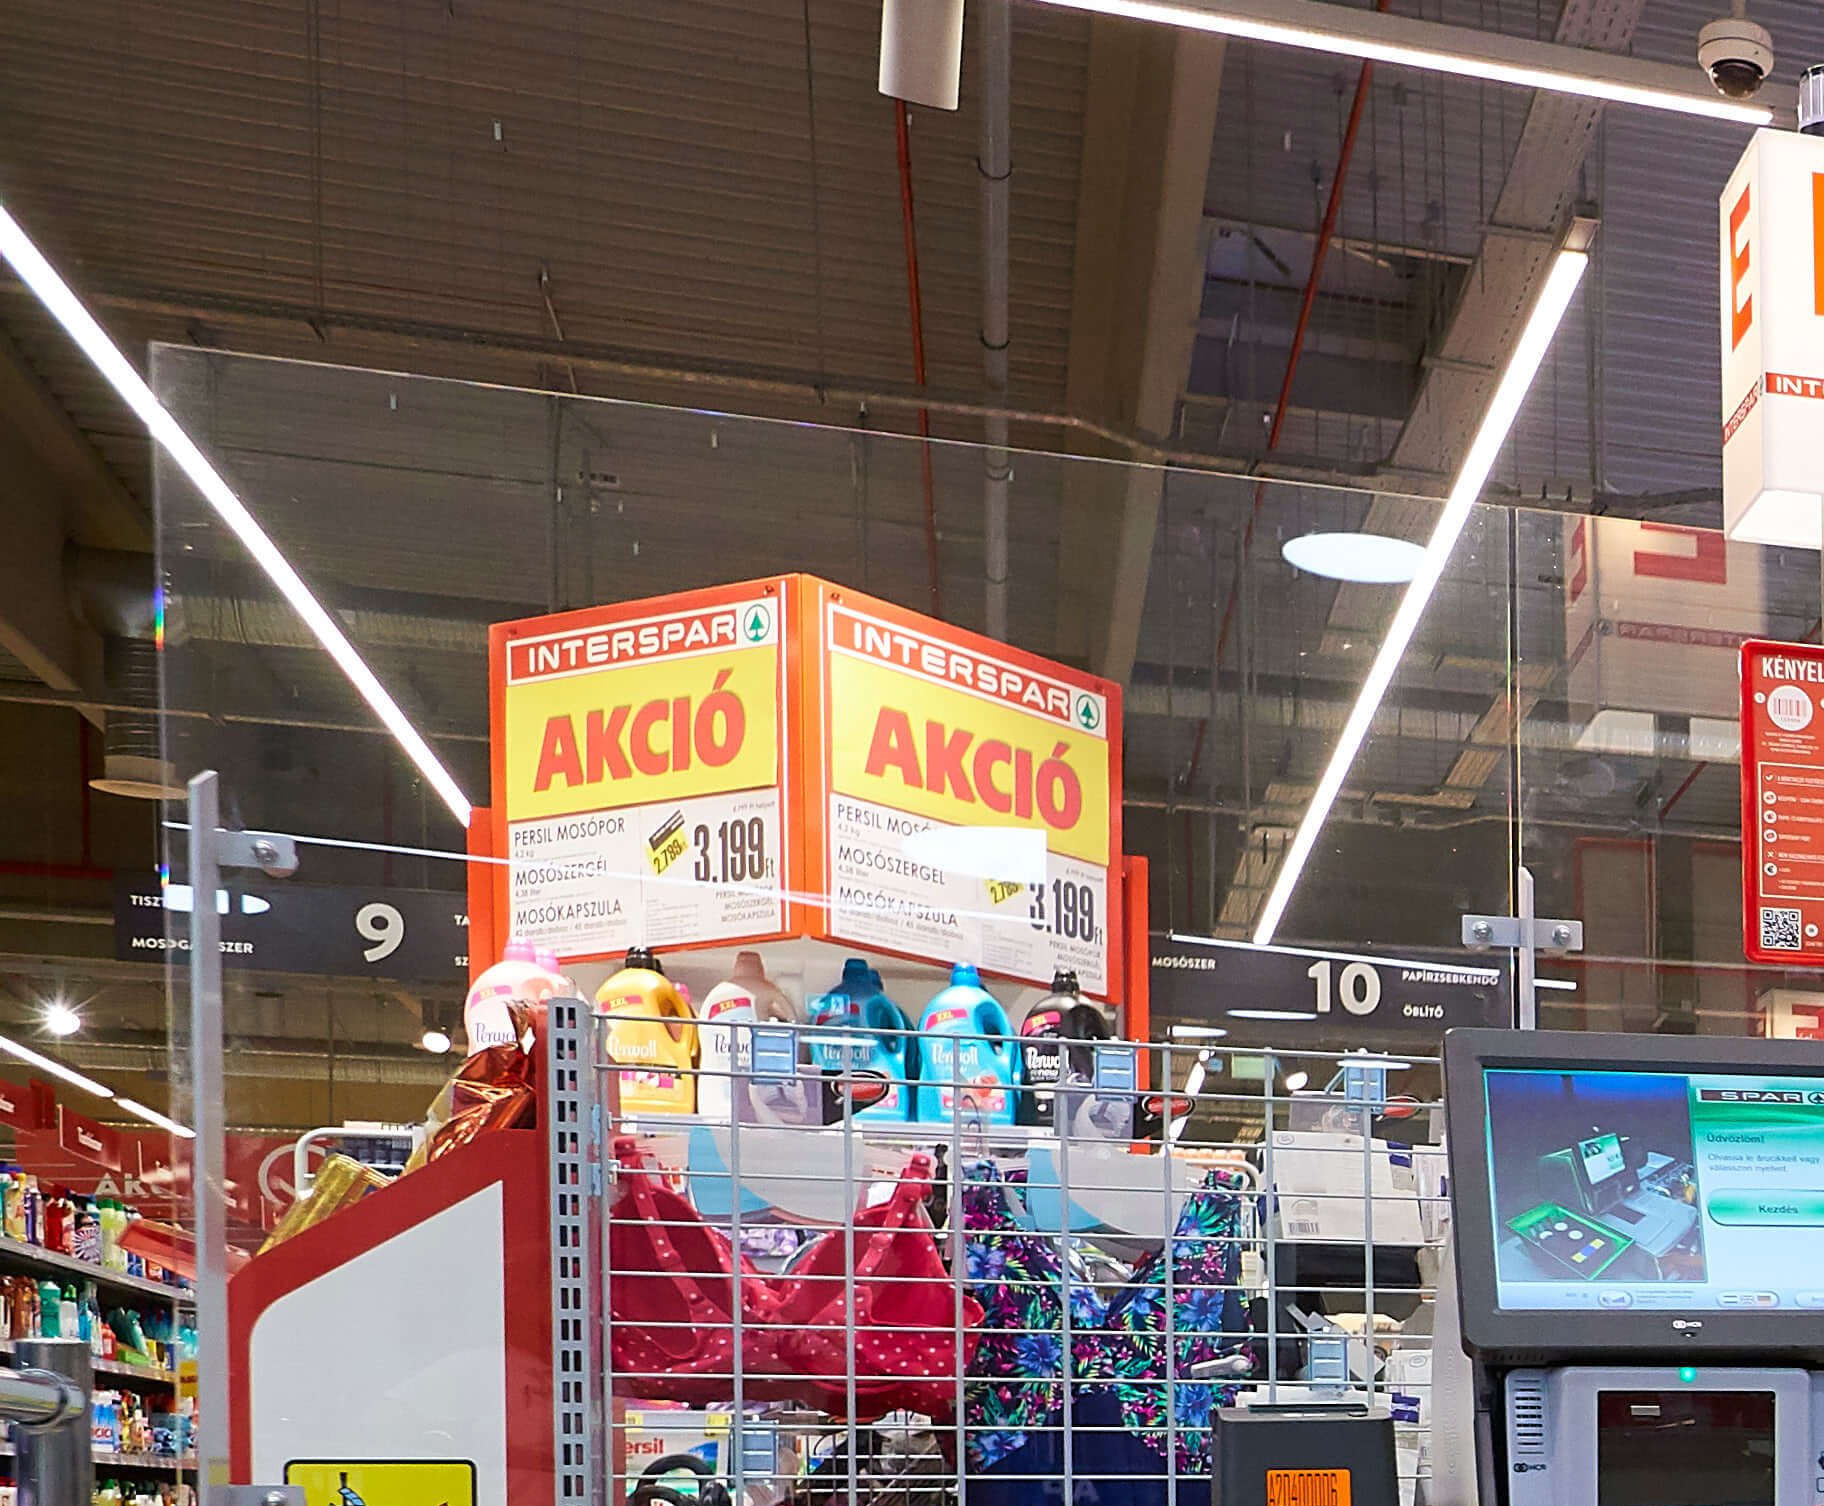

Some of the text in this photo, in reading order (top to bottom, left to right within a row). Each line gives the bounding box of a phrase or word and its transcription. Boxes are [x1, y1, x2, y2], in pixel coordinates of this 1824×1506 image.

[1730, 182, 1753, 352] E
[527, 614, 736, 673] INTERSPAR
[853, 621, 1069, 718] INTERSPAR
[533, 669, 746, 792] AKCIÓ
[864, 703, 1082, 831] AKCIÓ
[514, 817, 626, 848] PERSIL MOSÓPOR
[837, 803, 883, 830] PERSIL
[694, 816, 776, 884] 3.199 Ft
[355, 902, 405, 963] 9
[515, 899, 623, 926] MOSÓKAPSZULA
[1030, 878, 1094, 943] 3.199
[1152, 955, 1217, 971] MOSÓSZER
[1307, 960, 1381, 1017] 10
[1720, 1091, 1801, 1103] SPAR
[625, 1437, 664, 1456] ersil
